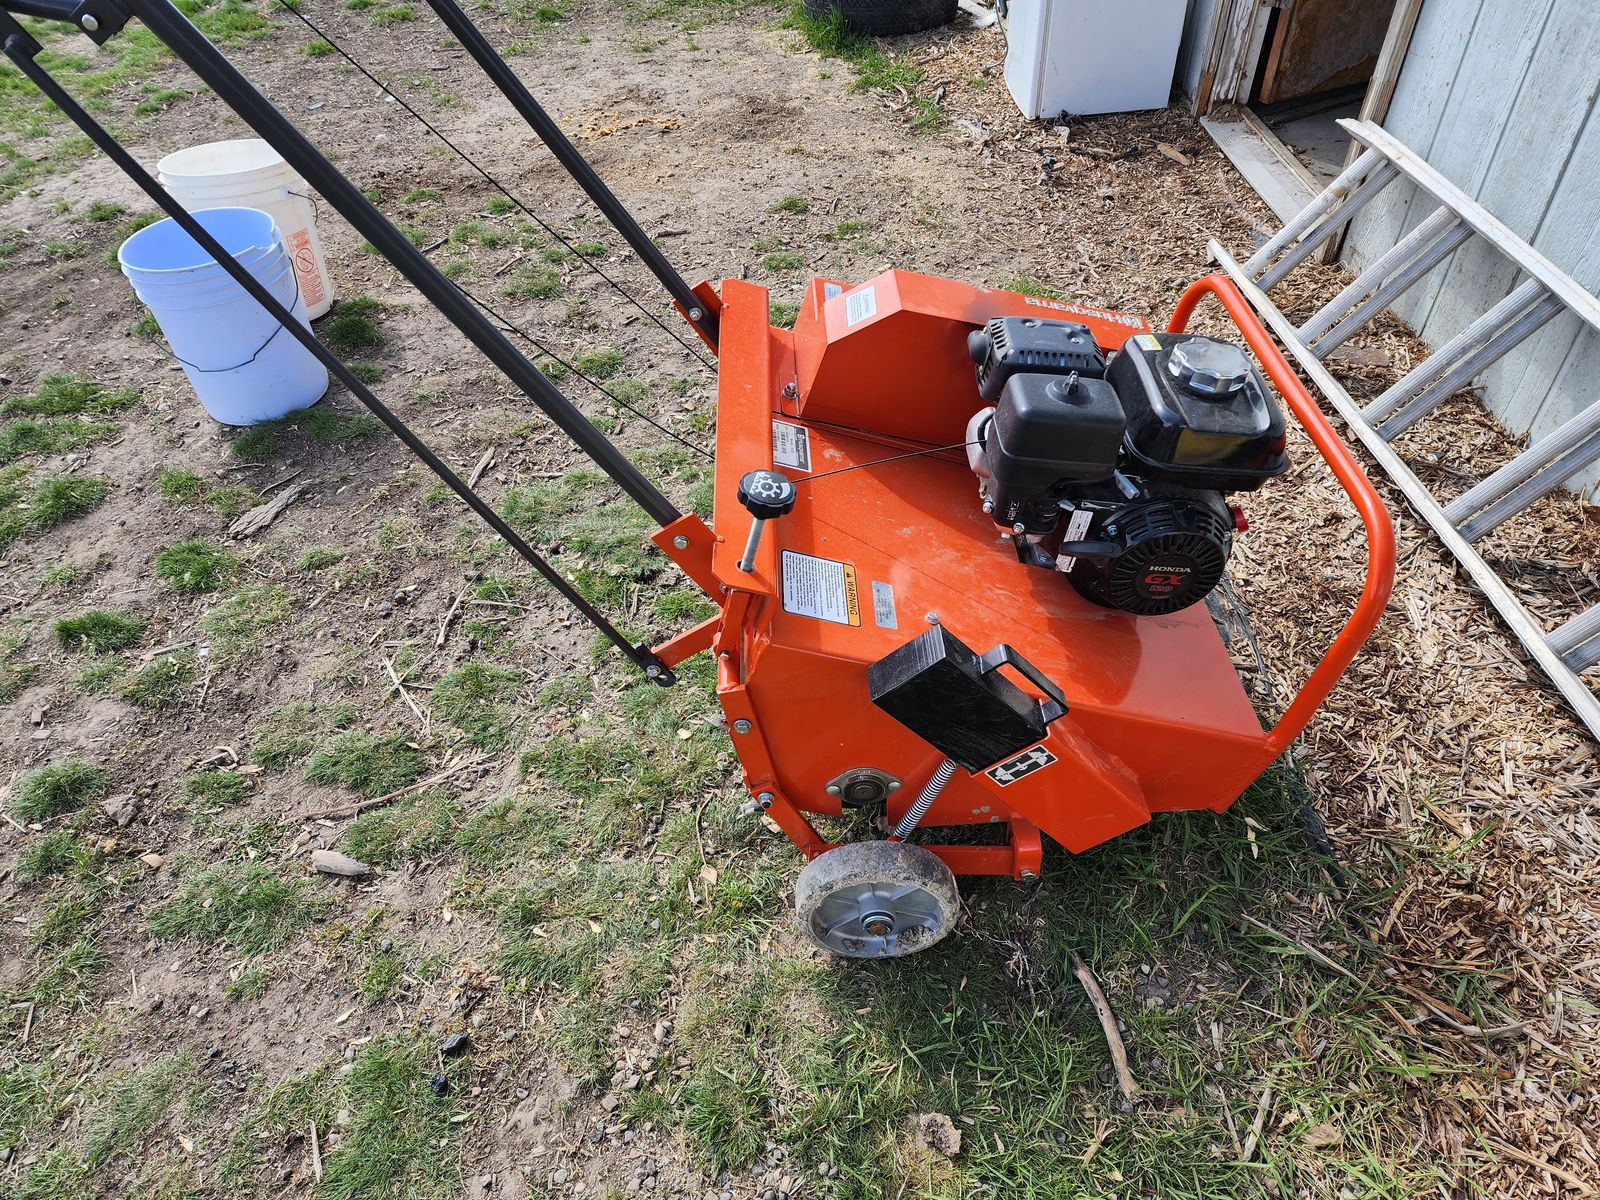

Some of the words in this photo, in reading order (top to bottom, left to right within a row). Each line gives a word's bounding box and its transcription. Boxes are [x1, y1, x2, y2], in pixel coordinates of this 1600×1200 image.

[1024, 296, 1120, 324] Husqvarna
[1144, 573, 1186, 585] GX
[1149, 565, 1191, 573] HONDA
[847, 581, 858, 616] WARNING
